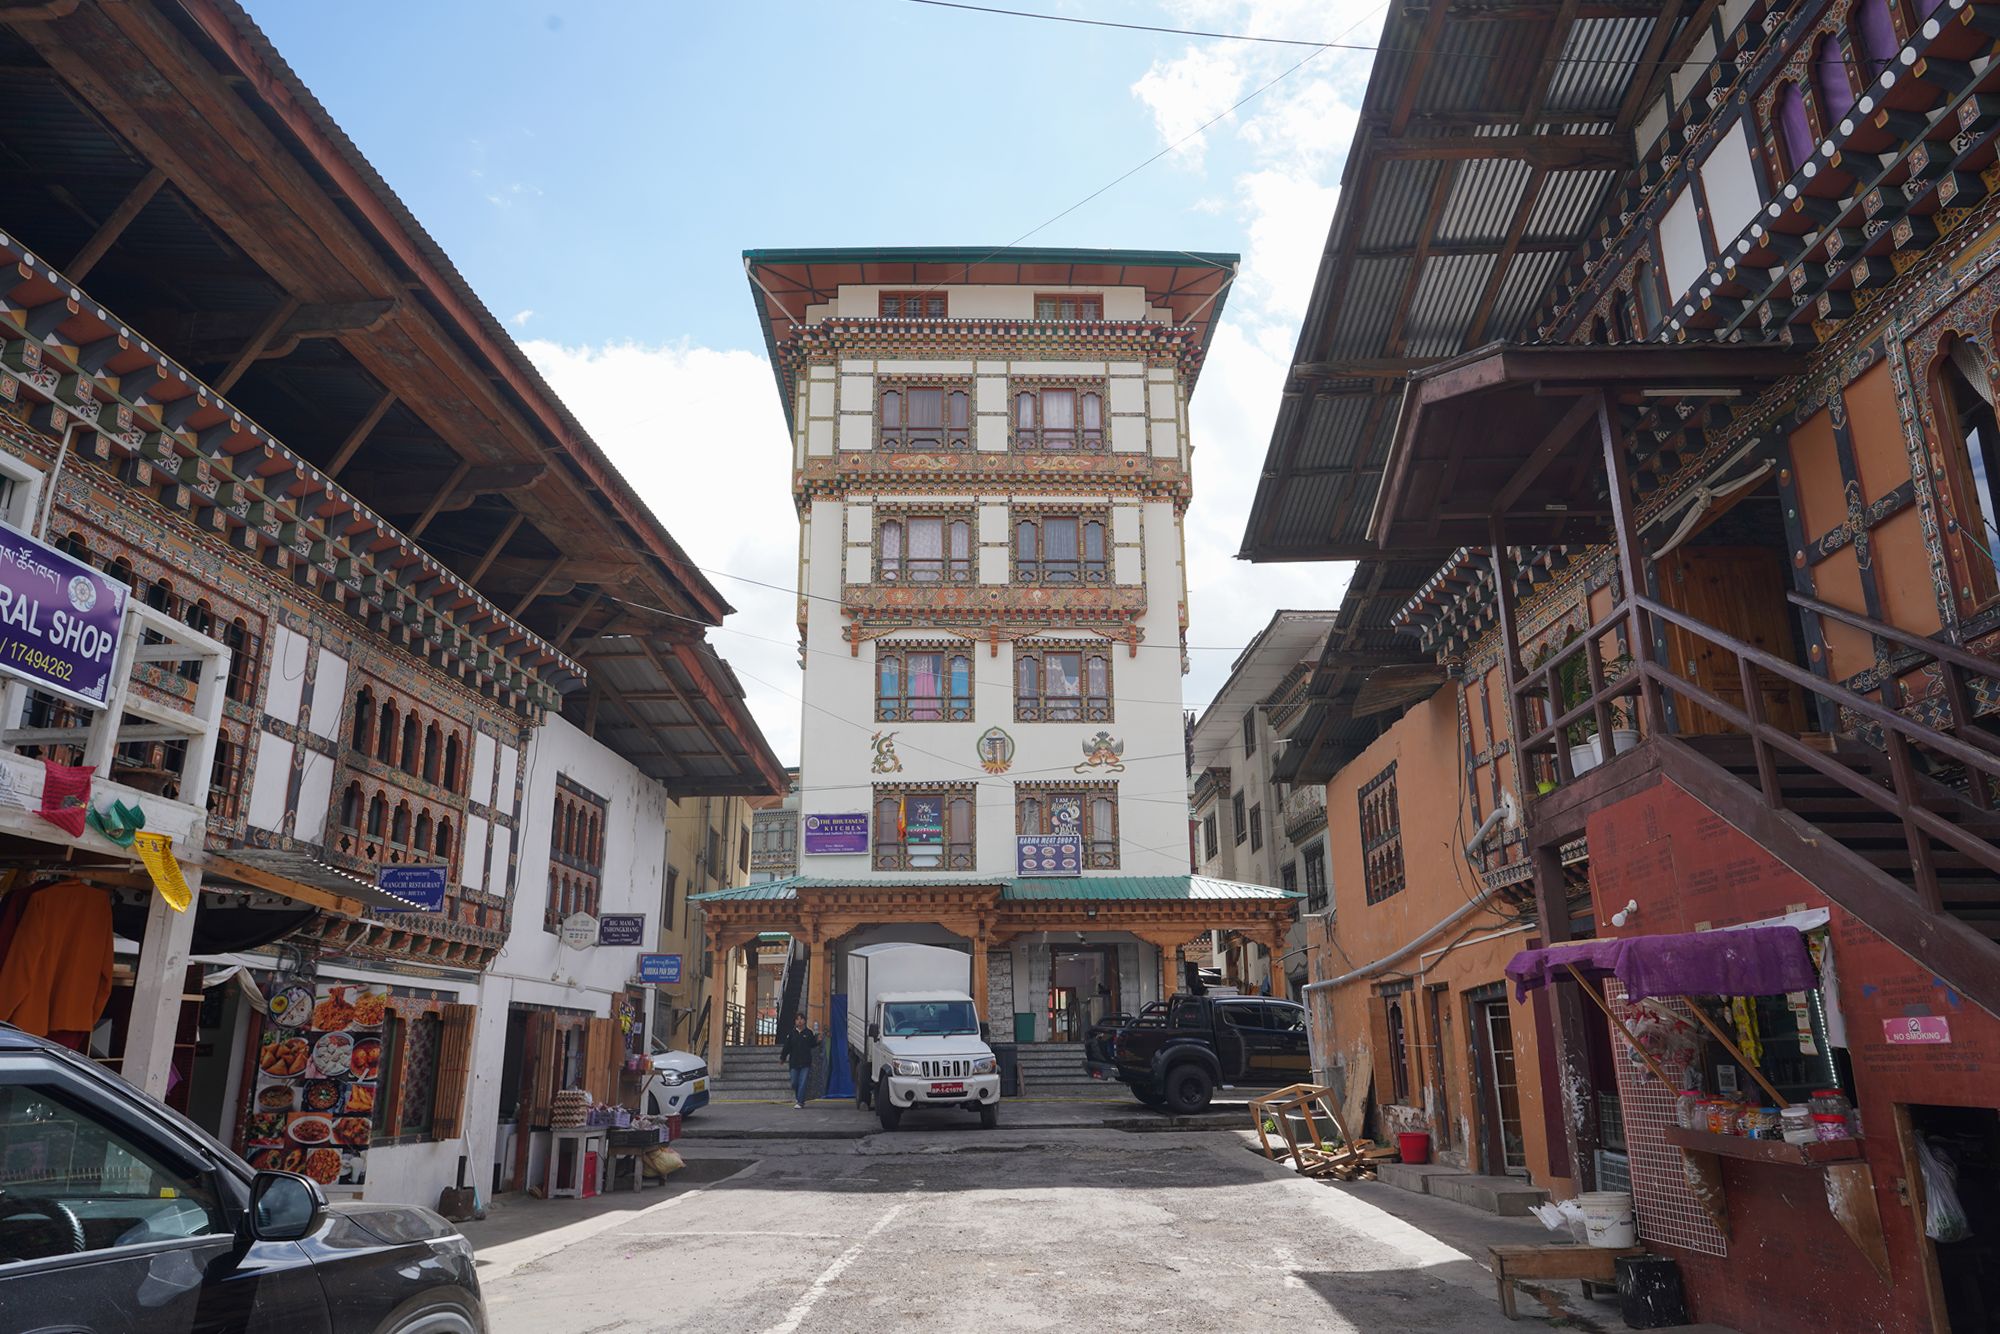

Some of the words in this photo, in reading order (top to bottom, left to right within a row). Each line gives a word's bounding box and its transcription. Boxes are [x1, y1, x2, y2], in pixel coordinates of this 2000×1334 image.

[49, 610, 113, 662] SHOP
[10, 642, 73, 681] 17494262
[1893, 1033, 1905, 1041] NO
[1905, 1032, 1941, 1040] SMOKING
